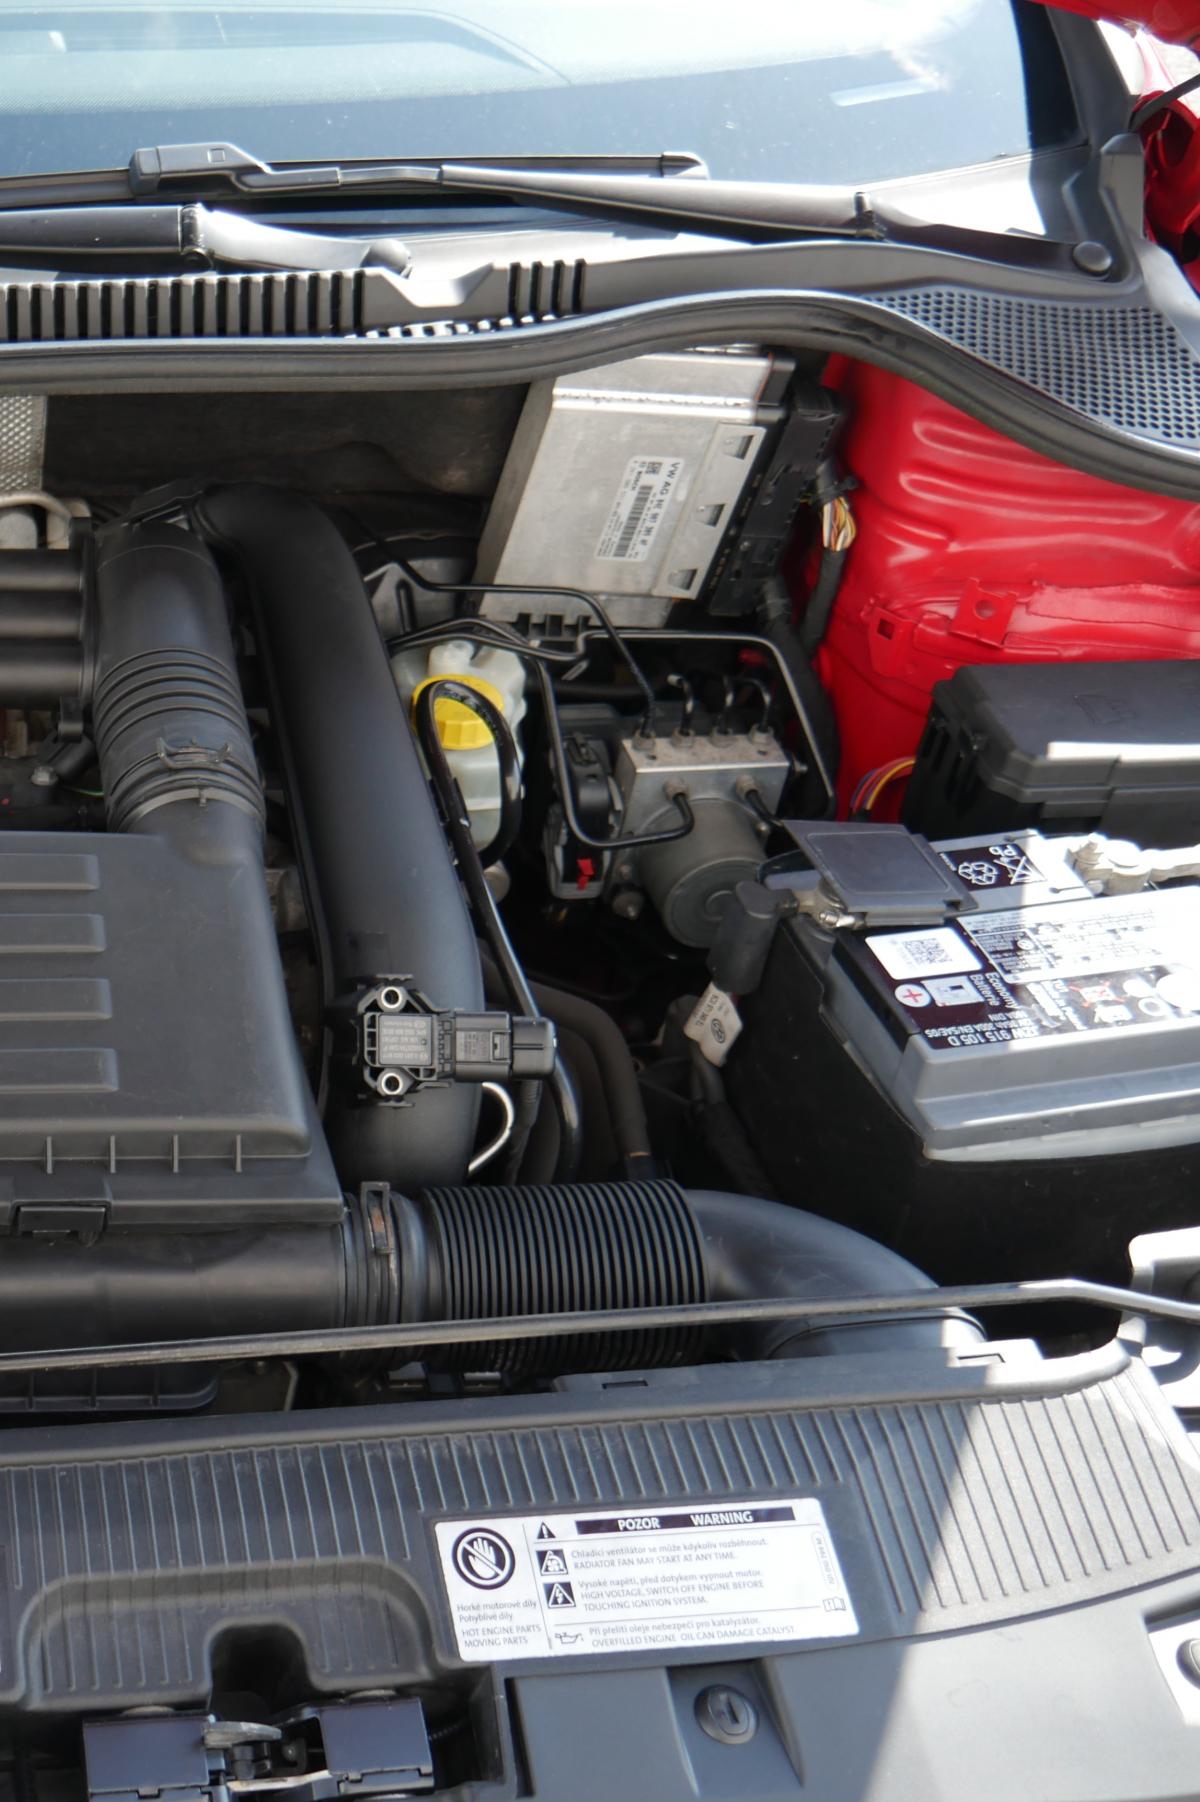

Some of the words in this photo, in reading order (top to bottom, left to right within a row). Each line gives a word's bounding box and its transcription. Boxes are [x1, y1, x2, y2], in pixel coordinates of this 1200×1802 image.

[988, 844, 1017, 857] Pb
[985, 972, 1019, 1009] Economy
[947, 1035, 962, 1047] D
[960, 1032, 986, 1045] 105
[984, 1029, 1013, 1042] 915
[617, 1517, 660, 1531] POZOR
[690, 1510, 754, 1526] WARNING
[574, 1558, 615, 1569] RADIATOR
[617, 1557, 636, 1567] FAN
[637, 1556, 655, 1565] MAY
[656, 1555, 681, 1565] START
[683, 1553, 693, 1562] AT
[695, 1552, 713, 1562] ANY
[660, 1573, 697, 1585] dotykem
[700, 1571, 733, 1582] vypnout
[580, 1590, 605, 1600] HIGH
[646, 1585, 679, 1596] SWITCH
[681, 1584, 697, 1594] OFF
[698, 1581, 731, 1592] ENGINE
[732, 1579, 764, 1590] BEFORE
[584, 1601, 631, 1612] TOUCHING
[632, 1598, 672, 1609] IGNITION
[462, 1628, 480, 1638] HOT
[482, 1626, 514, 1636] ENGINE
[516, 1623, 541, 1634] PARTS
[629, 1624, 651, 1634] oleje
[695, 1620, 711, 1630] pro
[464, 1637, 501, 1648] MOVING
[503, 1635, 528, 1645] PARTS
[591, 1636, 642, 1647] OVERFILLED
[644, 1634, 677, 1644] ENGINE
[680, 1632, 695, 1642] OIL
[697, 1630, 716, 1640] CAN
[717, 1628, 755, 1639] DAMAGE
